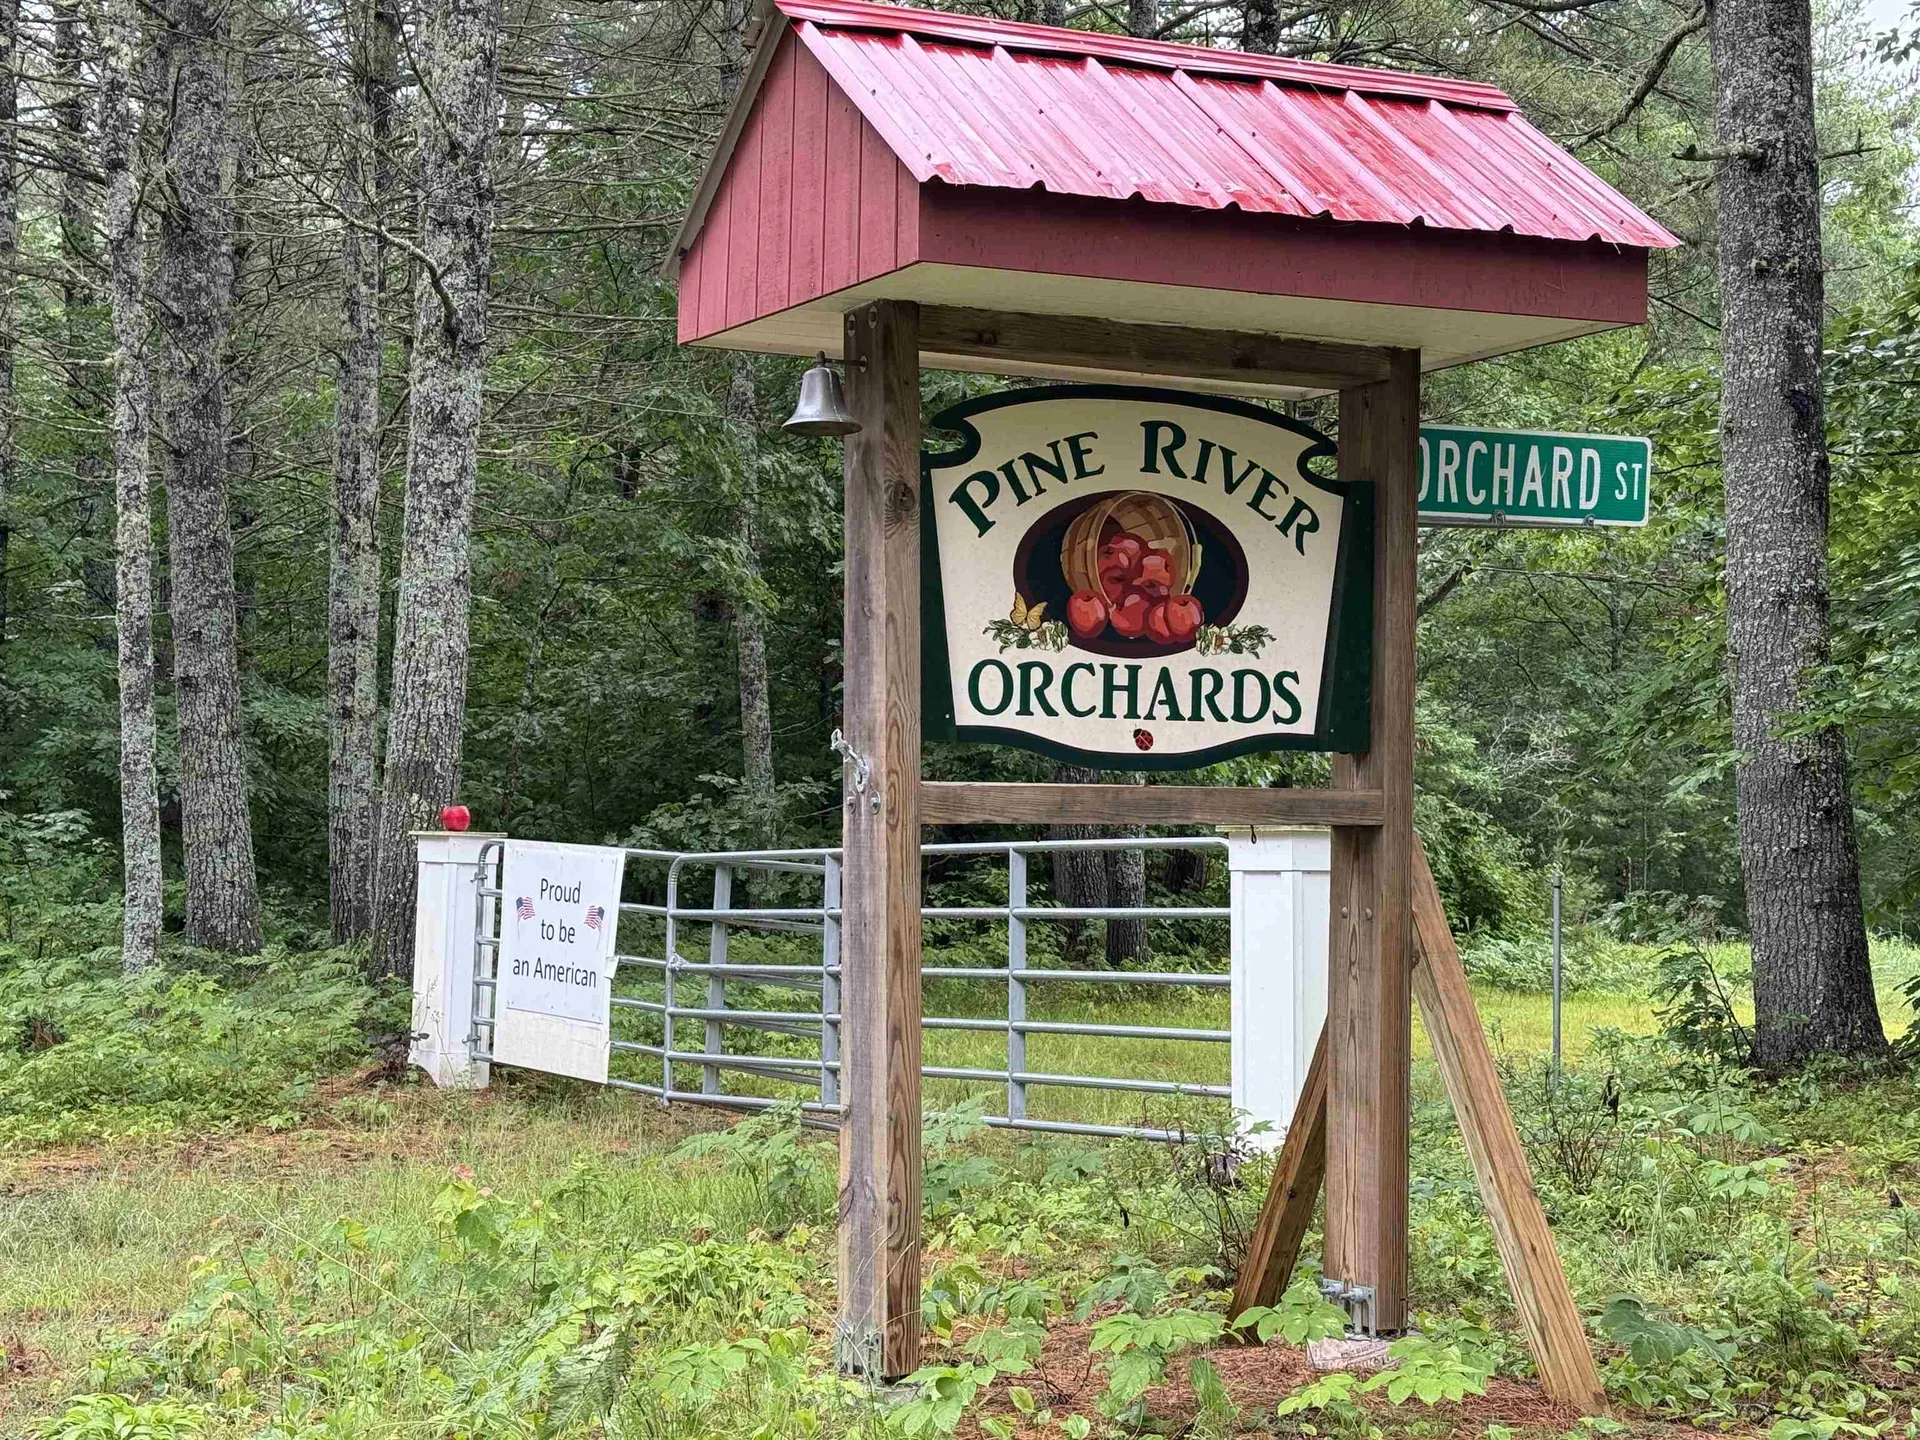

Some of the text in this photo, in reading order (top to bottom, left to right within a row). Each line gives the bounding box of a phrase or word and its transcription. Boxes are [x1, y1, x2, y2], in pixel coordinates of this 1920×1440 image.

[948, 420, 1321, 556] PINE RIVER
[1614, 462, 1643, 500] ST
[967, 658, 1303, 726] ORCHARDS
[540, 878, 581, 904] Proud
[541, 918, 576, 943] to be
[512, 957, 597, 988] an American
